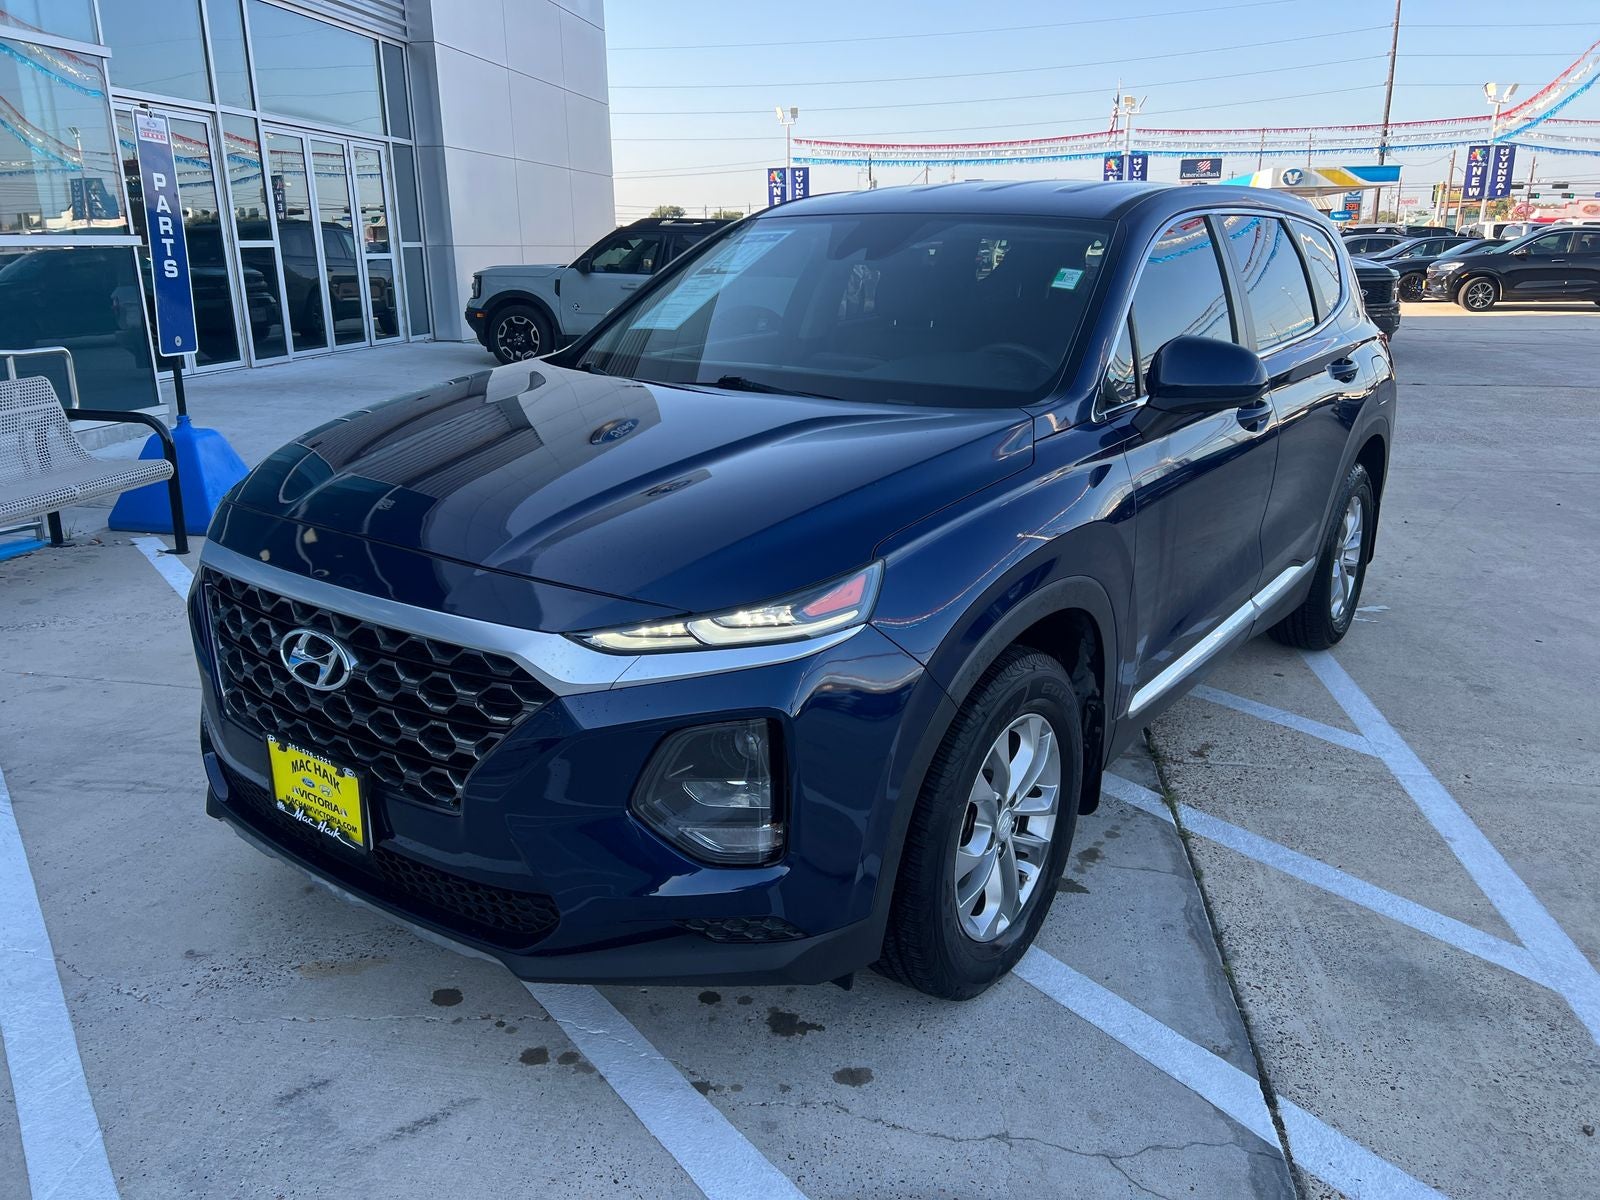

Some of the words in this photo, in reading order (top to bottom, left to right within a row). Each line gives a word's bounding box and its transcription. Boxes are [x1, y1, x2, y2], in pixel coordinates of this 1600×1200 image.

[1468, 166, 1482, 196] NEW
[1495, 148, 1510, 196] HYUNDAI
[152, 172, 179, 278] PARTS
[291, 758, 312, 774] MAC
[313, 761, 341, 795] HAIK
[293, 807, 317, 828] Mac
[298, 787, 340, 815] VICTORIA
